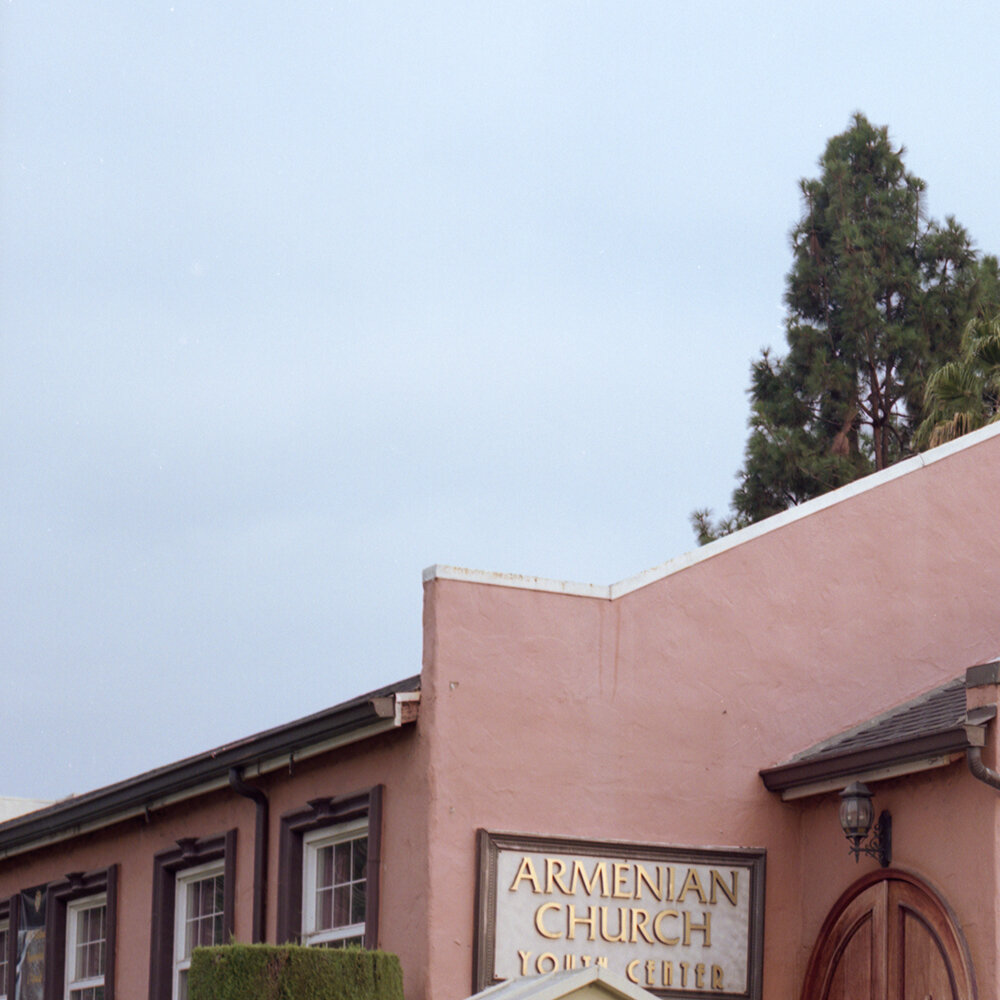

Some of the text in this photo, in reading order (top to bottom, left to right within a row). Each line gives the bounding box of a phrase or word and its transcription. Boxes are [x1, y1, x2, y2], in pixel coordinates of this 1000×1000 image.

[509, 857, 740, 906] ARMENIAN
[534, 902, 713, 948] CHURCH
[626, 959, 725, 990] CENTER
